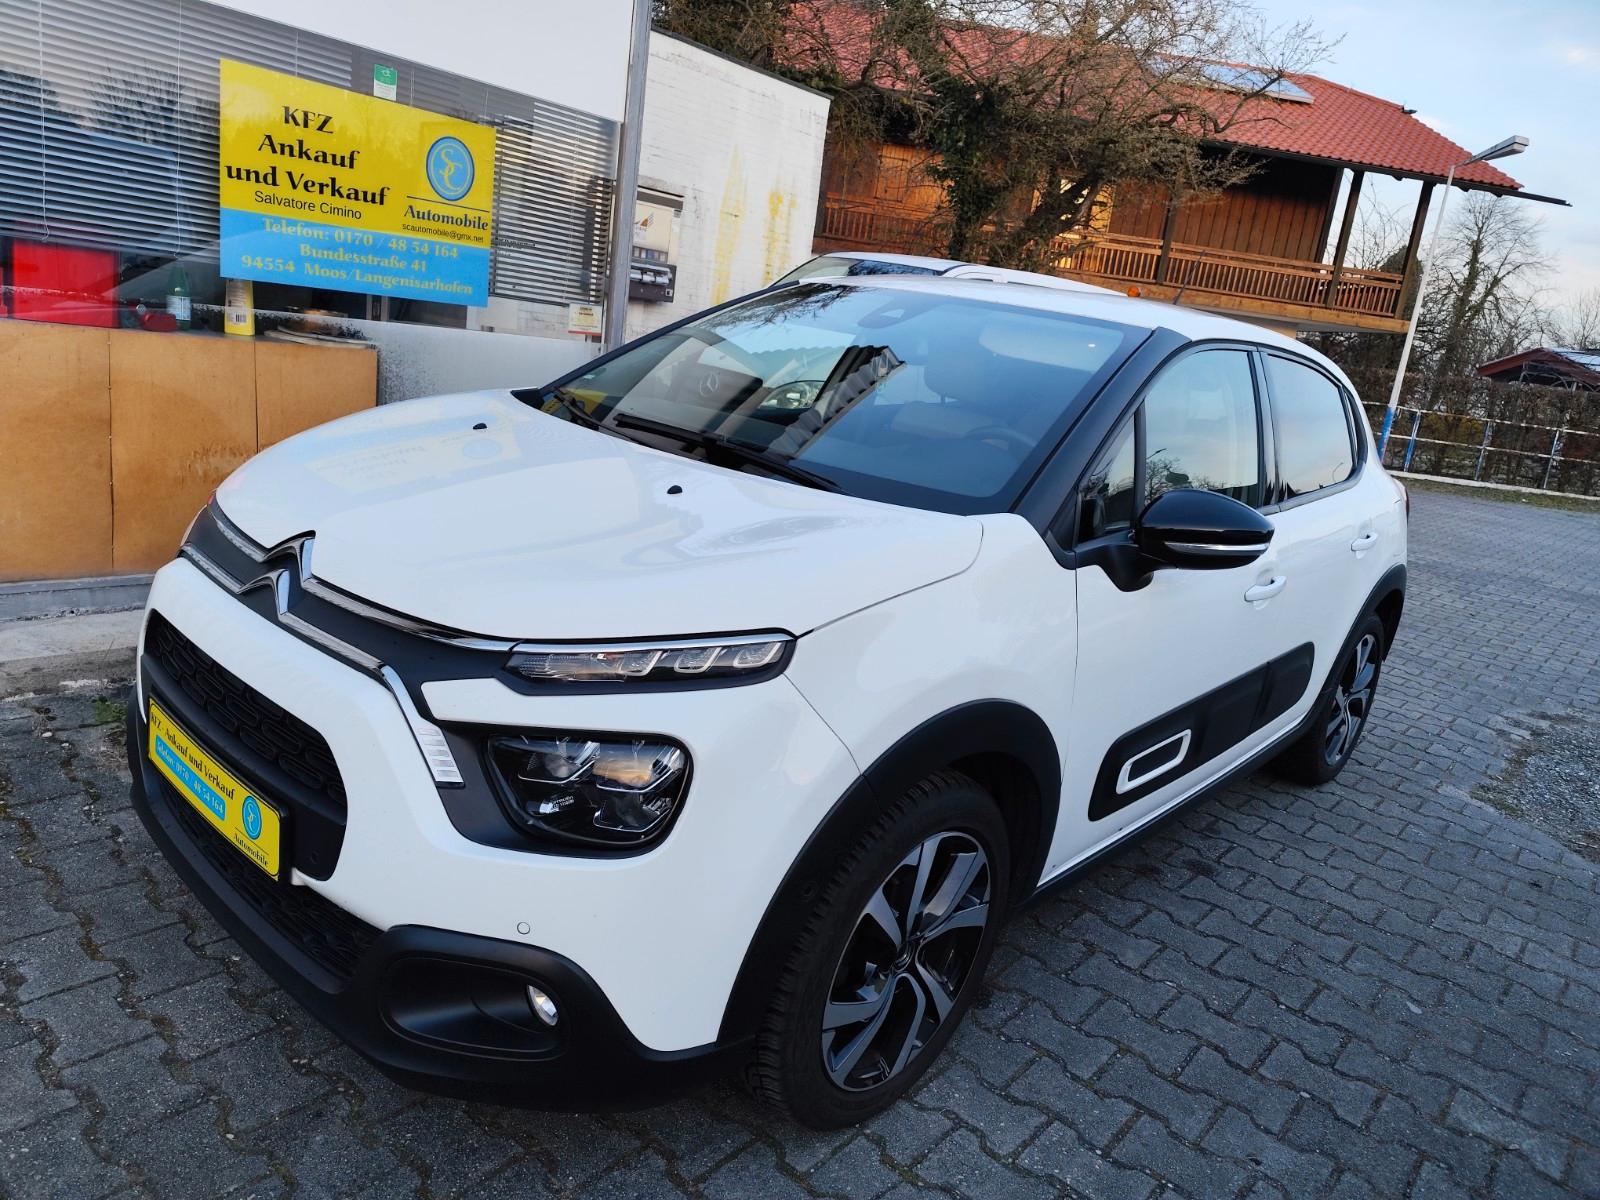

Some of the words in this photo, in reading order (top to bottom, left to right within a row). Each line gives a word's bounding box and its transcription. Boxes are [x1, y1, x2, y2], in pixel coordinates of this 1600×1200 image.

[282, 105, 334, 135] KFZ
[258, 134, 361, 169] Ankauf
[224, 165, 280, 187] und
[285, 171, 391, 206] Verkauf
[254, 190, 316, 212] Salvatore
[319, 202, 362, 220] Cimino
[403, 204, 489, 231] Automobile
[263, 217, 330, 241] Telefon:
[334, 229, 374, 247] 0170
[388, 238, 407, 252] 48
[411, 241, 429, 256] 54
[434, 243, 459, 259] 164
[402, 222, 484, 243] scautomobile@gmx.net
[241, 254, 295, 273] 94554
[299, 243, 407, 270] Bundesstraße
[411, 259, 427, 273] 41
[165, 727, 188, 758] Ankauf
[188, 753, 203, 773] und
[204, 765, 236, 800] Verkauf
[211, 796, 224, 814] 164
[233, 832, 270, 868] Automobile
